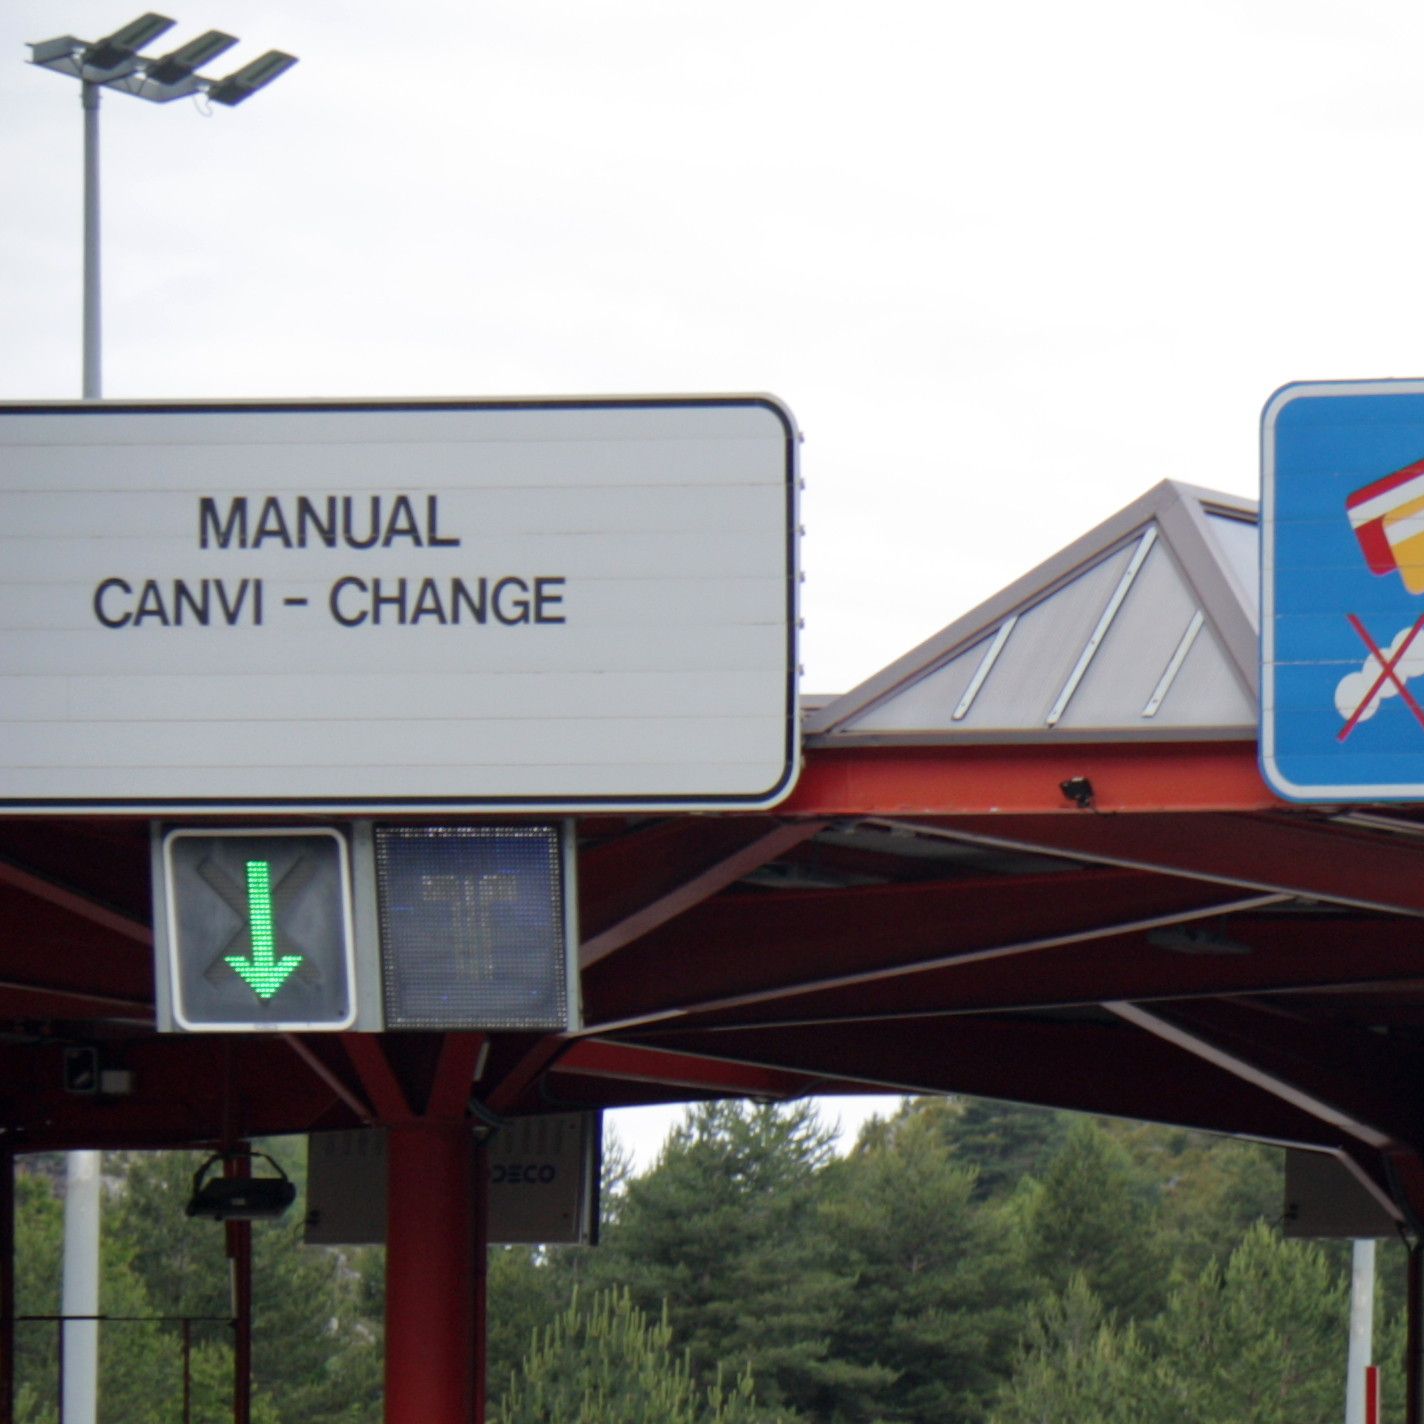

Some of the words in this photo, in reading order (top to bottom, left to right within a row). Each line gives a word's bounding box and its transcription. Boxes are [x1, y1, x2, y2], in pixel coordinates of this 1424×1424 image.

[199, 495, 462, 551] MANUAL
[93, 577, 264, 630] CANVI
[329, 576, 568, 629] CHANGE
